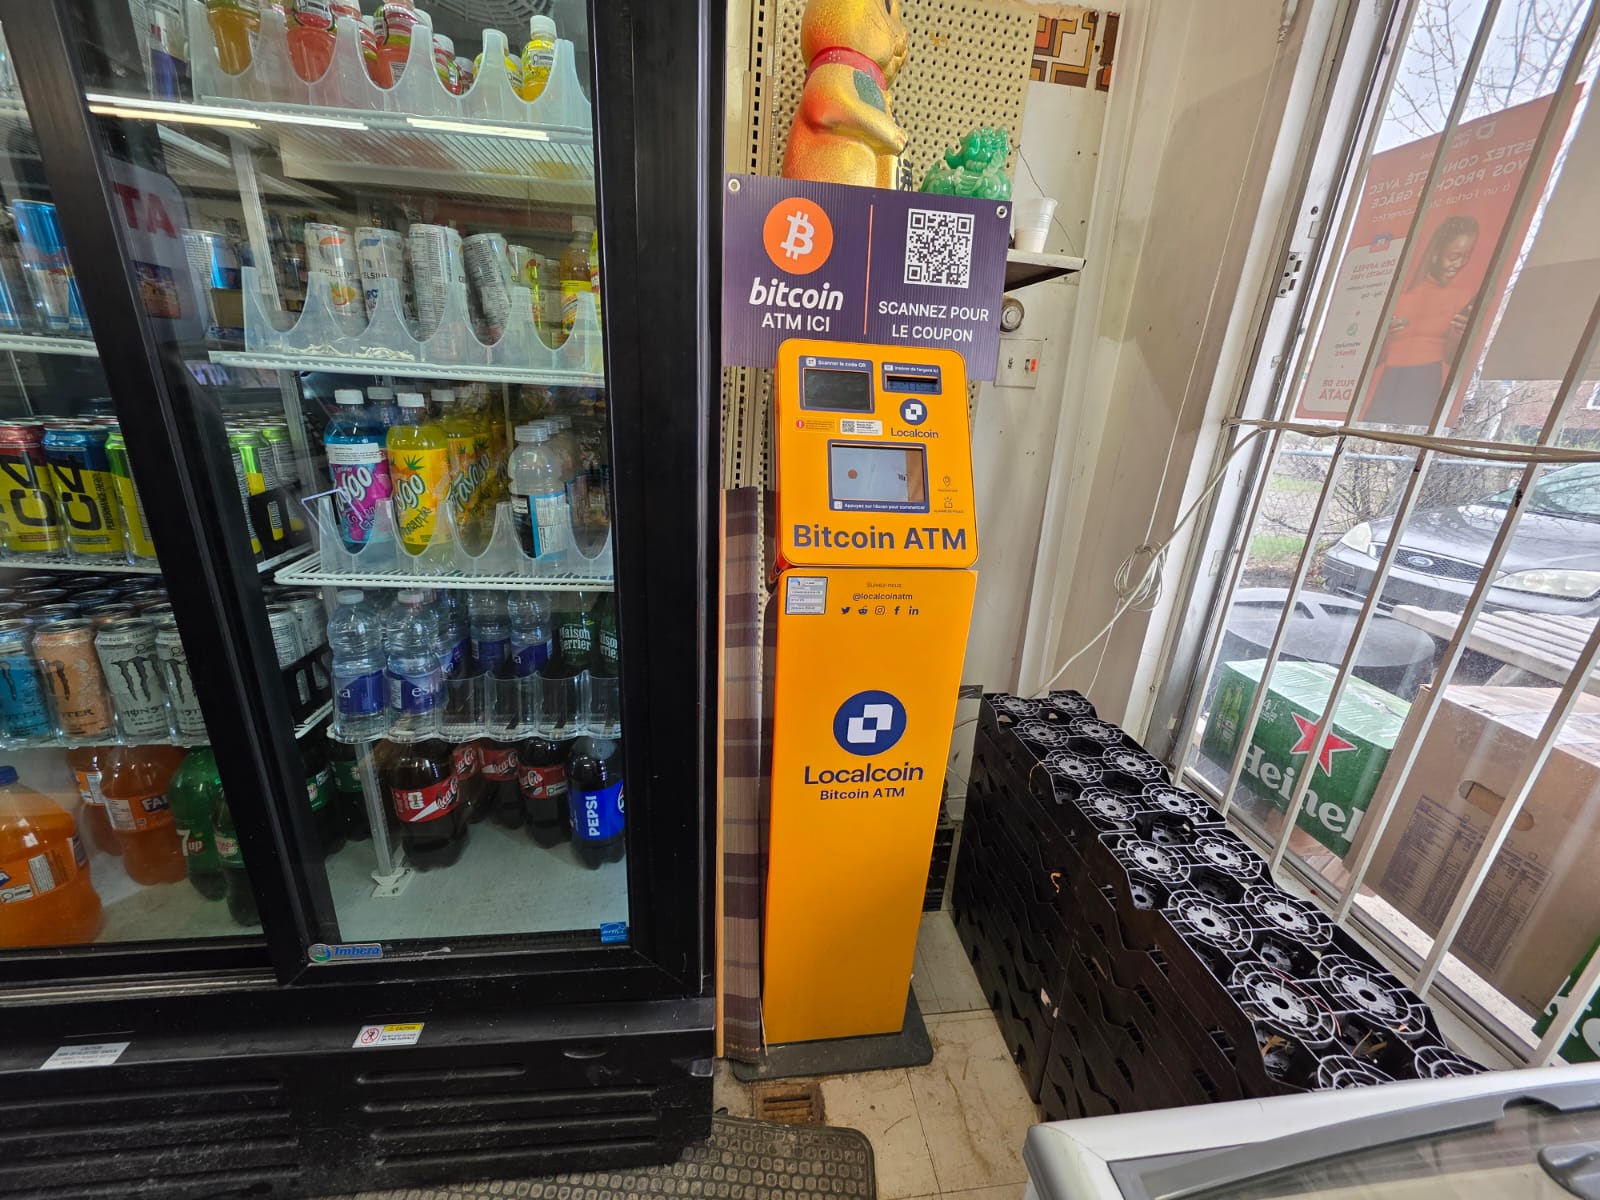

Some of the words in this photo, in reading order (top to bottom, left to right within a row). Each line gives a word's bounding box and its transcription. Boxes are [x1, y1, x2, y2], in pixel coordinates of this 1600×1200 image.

[749, 277, 844, 311] bitcoin
[878, 301, 947, 319] SCANNEZ
[950, 305, 989, 322] POUR
[761, 313, 802, 330] ATM
[807, 316, 830, 332] ICI
[892, 325, 909, 338] LE
[912, 327, 973, 342] COUPON
[890, 428, 939, 439] Localcoin
[793, 524, 895, 549] Bitcoin
[903, 527, 967, 550] ATM
[853, 592, 913, 602] @localcoinatm
[562, 638, 592, 651] errier
[804, 762, 924, 785] Localcoin
[820, 788, 869, 800] Bitcoin
[872, 787, 905, 798] ATM
[585, 795, 600, 837] PEPSI
[335, 945, 381, 957] Imbera
